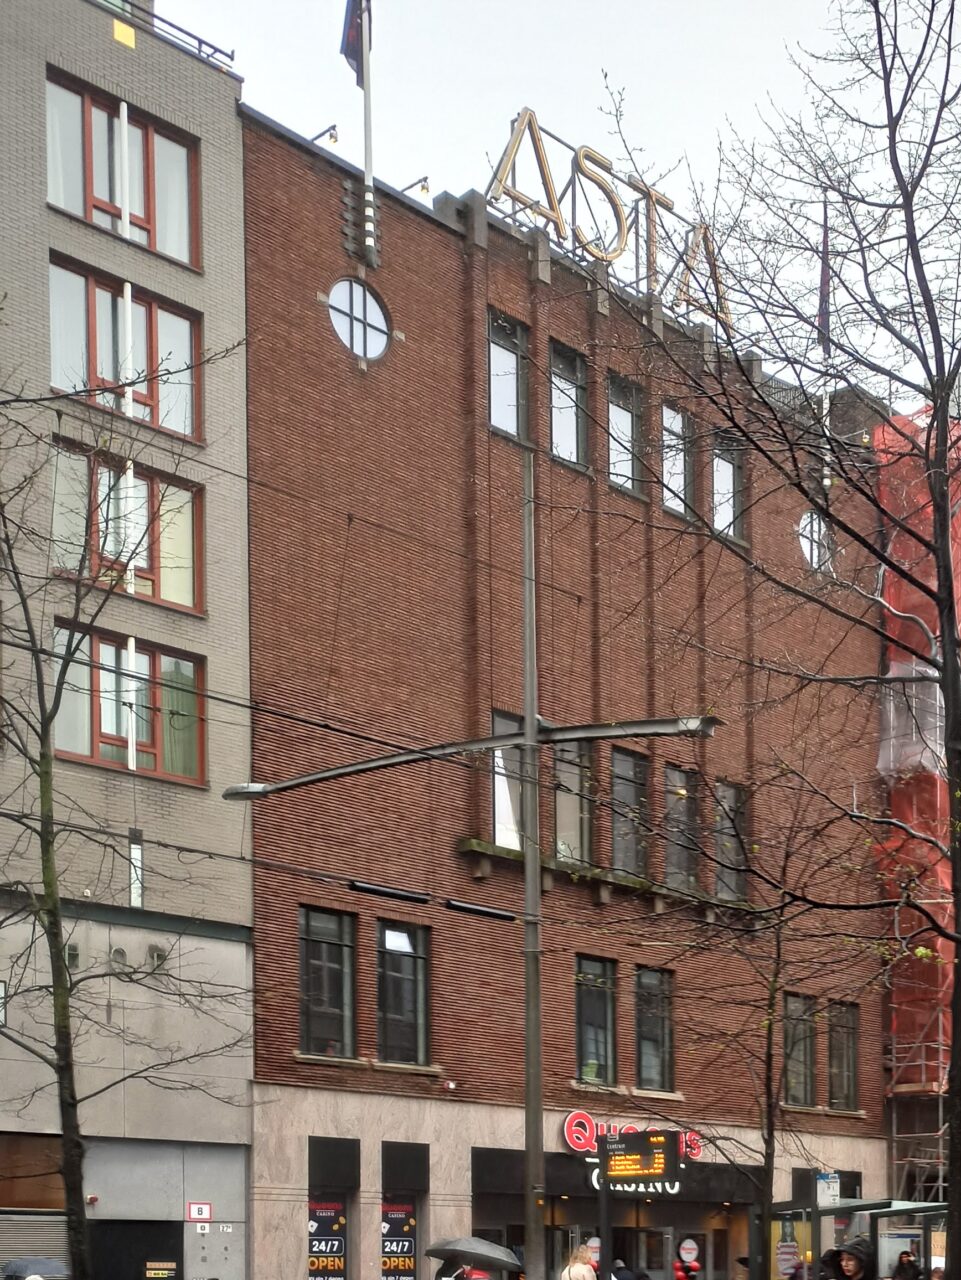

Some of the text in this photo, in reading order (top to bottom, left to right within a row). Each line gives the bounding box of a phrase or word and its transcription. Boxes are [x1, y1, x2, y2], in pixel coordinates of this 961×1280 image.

[490, 106, 736, 340] ASTA
[197, 1207, 203, 1216] B
[312, 1241, 339, 1252] 24/7
[384, 1241, 409, 1252] 24/7
[309, 1257, 344, 1270] OPEN
[381, 1257, 414, 1270] OPEN
